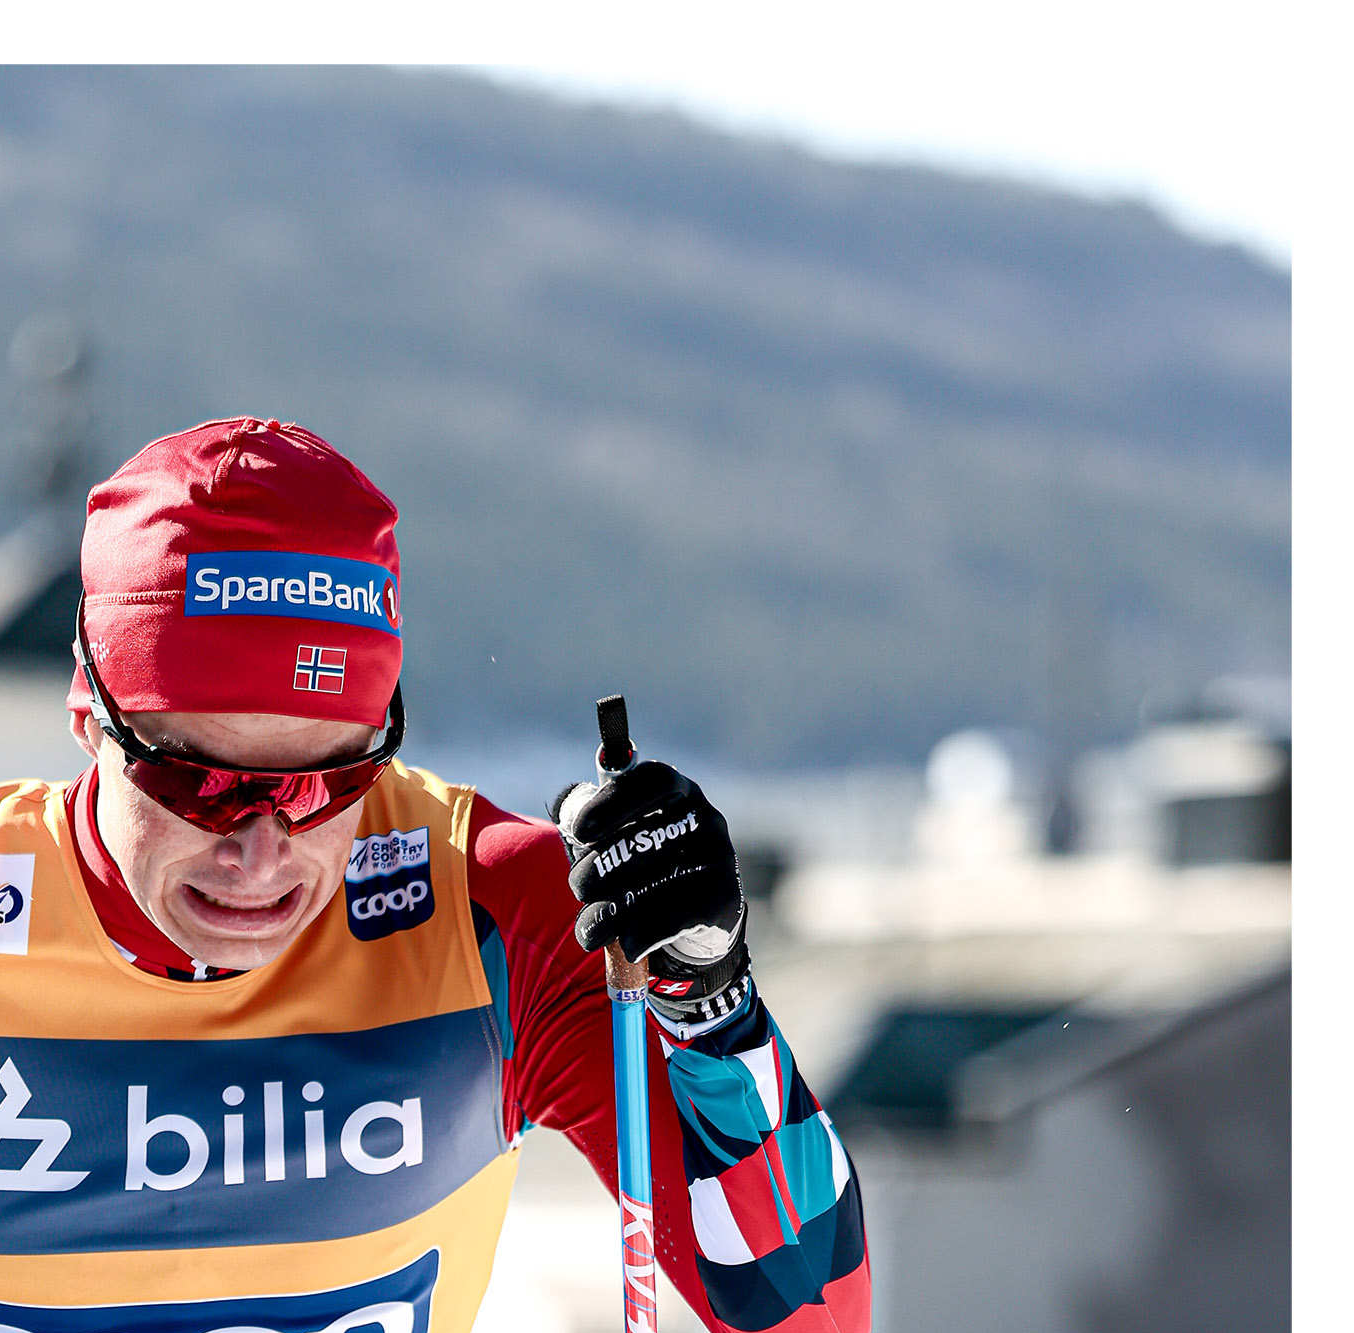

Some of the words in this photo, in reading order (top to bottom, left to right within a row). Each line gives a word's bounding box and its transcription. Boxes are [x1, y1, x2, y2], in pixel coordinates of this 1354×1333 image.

[194, 568, 382, 616] SpareBank
[402, 853, 421, 861] CUP
[351, 880, 428, 920] coop
[124, 1080, 424, 1192] bilia
